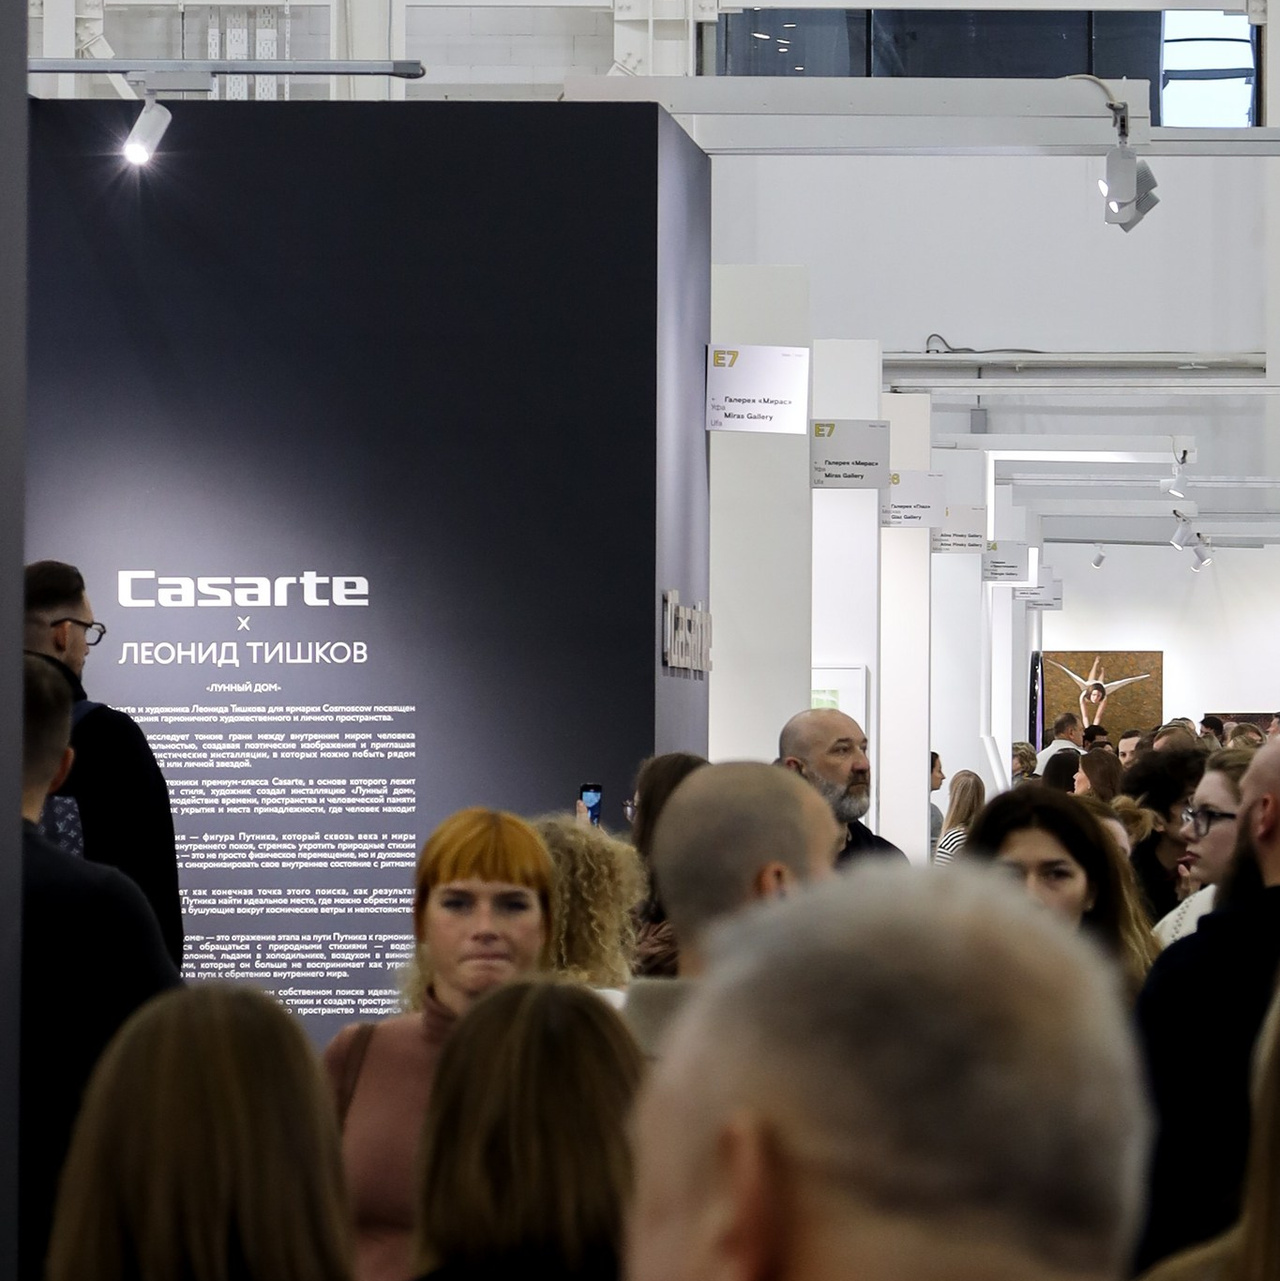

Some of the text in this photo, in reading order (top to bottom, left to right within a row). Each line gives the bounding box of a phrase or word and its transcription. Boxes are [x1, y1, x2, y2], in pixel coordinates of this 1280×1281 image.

[724, 396, 792, 405] Галерея «Мирас»
[746, 412, 773, 421] Gallery
[118, 570, 369, 607] Casarte
[118, 641, 368, 667] ЛЕОНИД ТИШКОВ
[145, 704, 415, 715] художника Леонида Тишкова ярмарки Cosmoscow посвящен
[160, 715, 218, 724] гармоничного
[219, 715, 292, 724] художественного
[336, 715, 393, 724] пространства.
[146, 734, 190, 743] исследует
[290, 734, 340, 743] внутренним
[202, 743, 241, 752] создавая
[300, 741, 356, 752] изображения
[370, 742, 415, 752] приглашая
[210, 750, 385, 761] инсталляции, которых побыть
[184, 759, 252, 770] личной звездой.
[201, 780, 269, 789] премиум-класса
[272, 778, 306, 788] Casarte,
[350, 779, 387, 788] которого
[210, 786, 388, 798] художник создал инсталляцию «Лунный
[221, 798, 259, 807] времени,
[261, 798, 318, 807] пространства
[327, 795, 385, 804] человеческой
[180, 807, 216, 816] укрытия
[254, 807, 326, 816] принадлежности,
[382, 807, 416, 815] находит
[202, 833, 235, 844] фигура
[239, 833, 279, 844] Путника,
[282, 832, 320, 844] который
[258, 843, 297, 853] стремясь
[298, 843, 336, 852] укротить
[337, 843, 385, 852] природные
[218, 851, 416, 862] просто физическое перемещение, духовное
[185, 862, 259, 871] синхронизировать
[281, 862, 328, 871] внутреннее
[315, 889, 349, 897] поиска,
[182, 896, 398, 908] Путника идеальное обрести
[188, 906, 235, 917] бушующие
[236, 908, 264, 917] вокруг
[231, 933, 367, 944] отражение Путника
[199, 942, 250, 953] обращаться
[268, 944, 322, 953] природными
